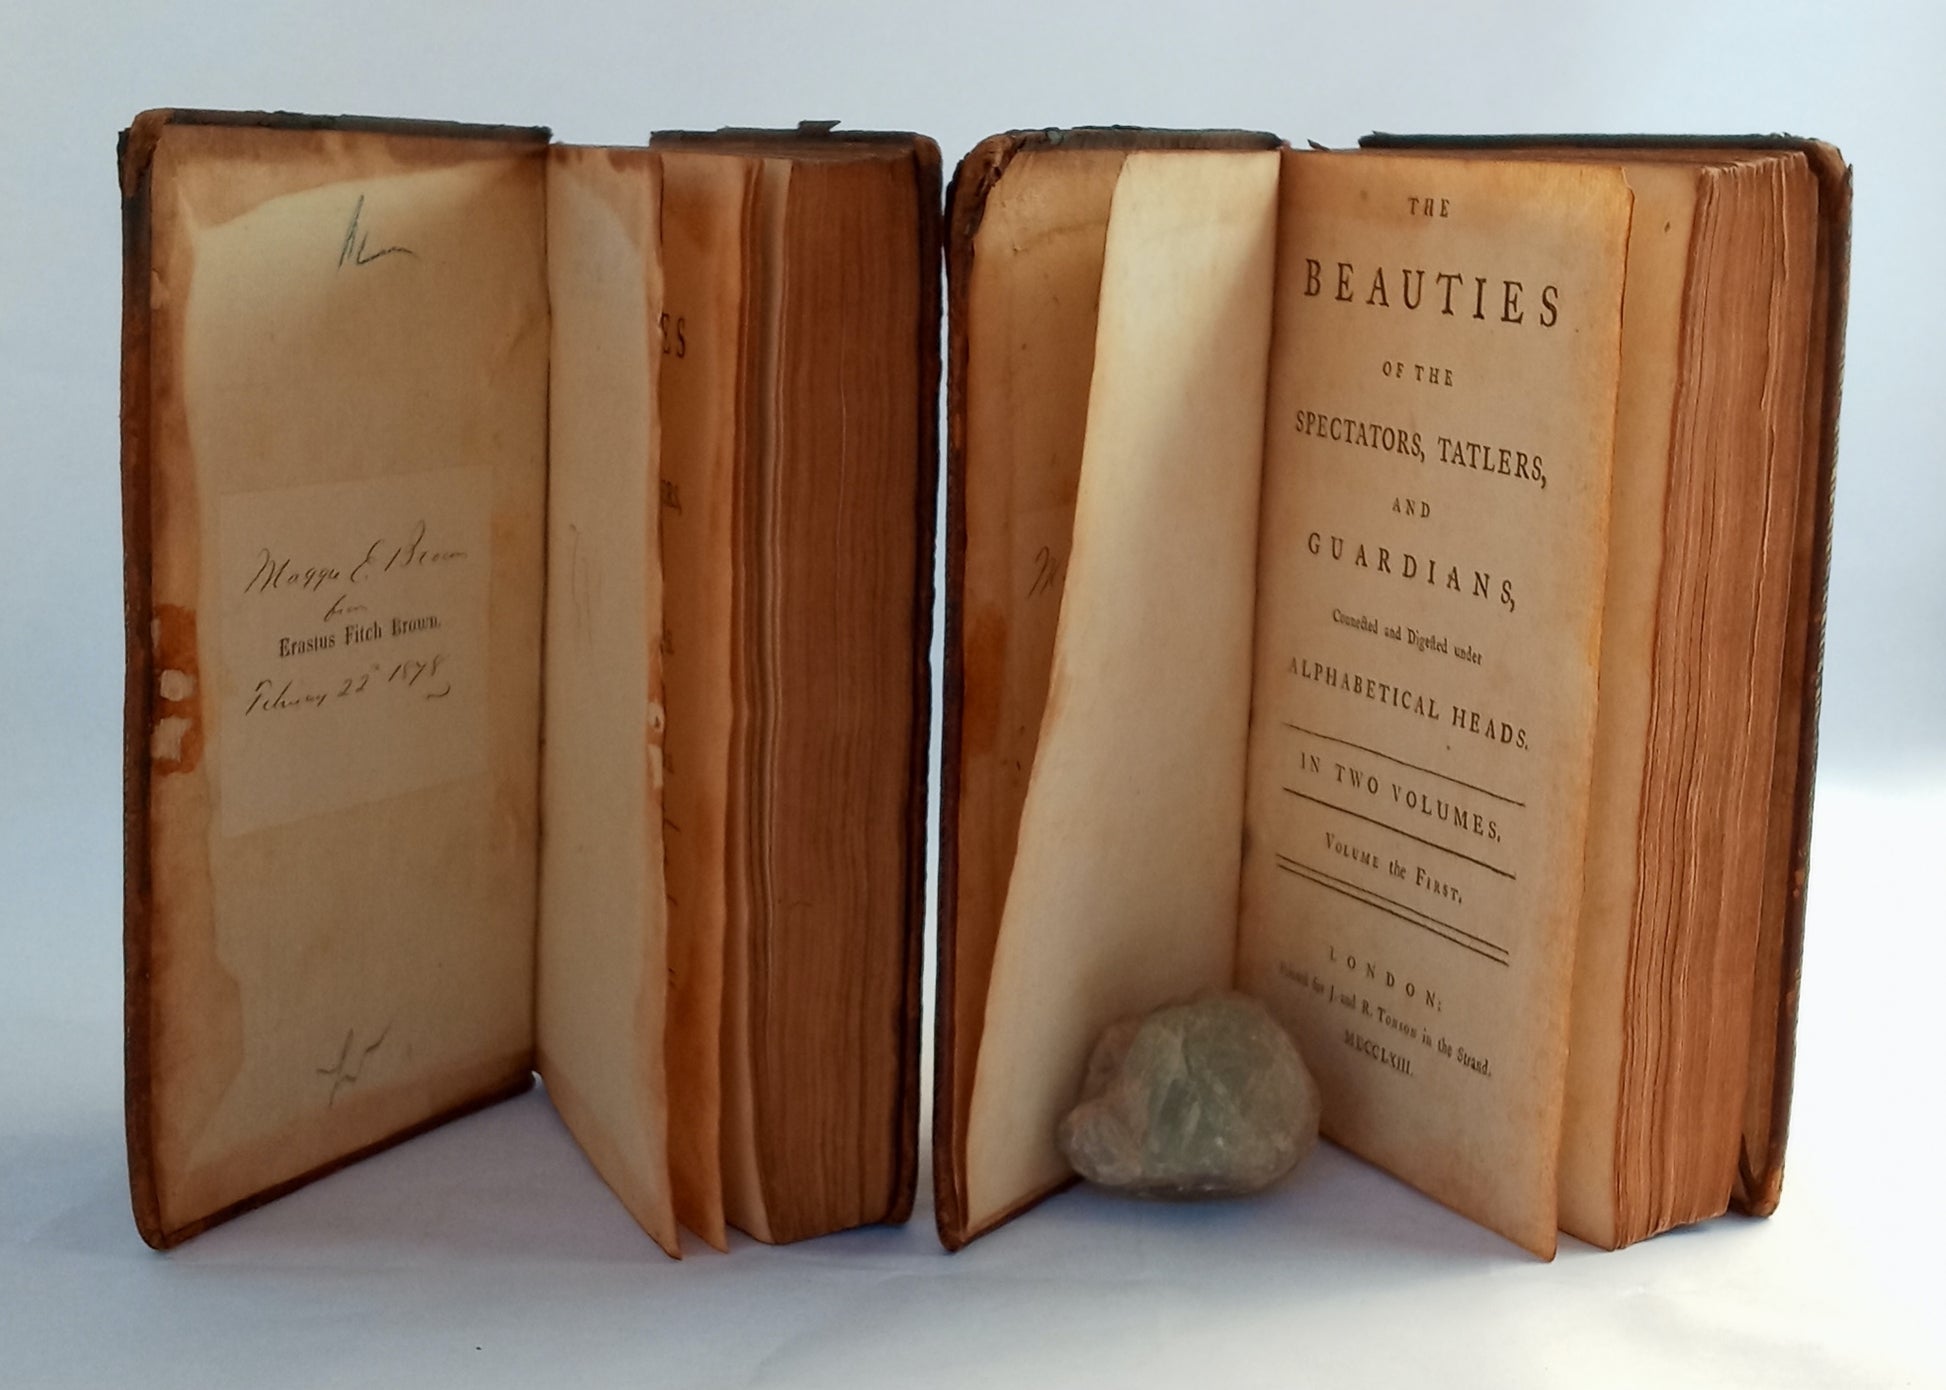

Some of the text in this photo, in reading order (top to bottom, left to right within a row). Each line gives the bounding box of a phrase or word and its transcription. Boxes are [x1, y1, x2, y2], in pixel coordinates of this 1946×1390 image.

[1407, 196, 1450, 219] THE
[1303, 257, 1560, 328] BEAUTIES
[1382, 360, 1454, 387] OF THE
[1295, 409, 1547, 490] SPECTATORS, TATLERS,
[1392, 497, 1432, 519] AND
[1308, 532, 1516, 612] GUARDIANS,
[279, 634, 336, 658] Erastus
[345, 620, 382, 646] Fitch
[1332, 608, 1378, 635] Connected
[1384, 626, 1402, 641] and
[1454, 643, 1483, 666] under
[1287, 656, 1530, 751] ALPHABETICAL HEADS.
[1301, 751, 1502, 843] IN TWO VOLUMES.
[1389, 860, 1407, 880] the
[1328, 945, 1442, 1013] LONDON:
[1422, 1026, 1433, 1046] in
[1437, 1037, 1453, 1058] the
[1457, 1046, 1492, 1078] Strand.
